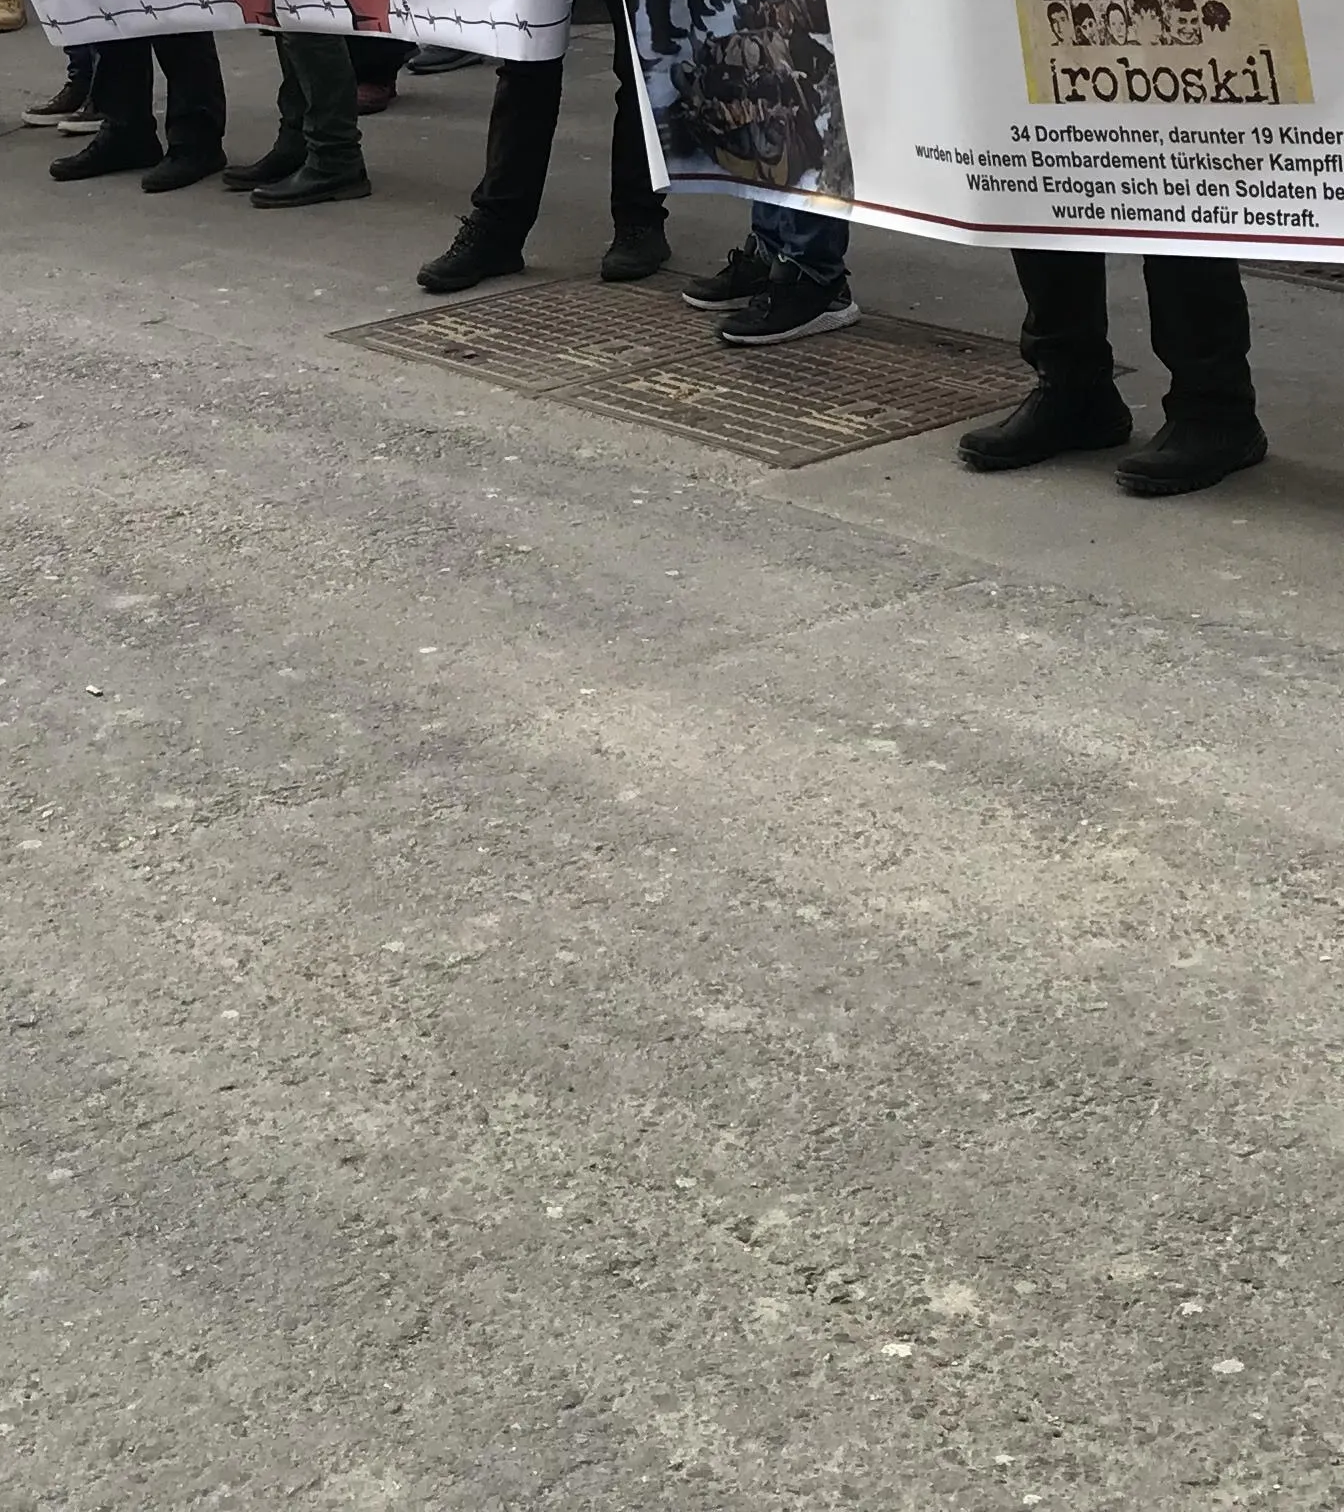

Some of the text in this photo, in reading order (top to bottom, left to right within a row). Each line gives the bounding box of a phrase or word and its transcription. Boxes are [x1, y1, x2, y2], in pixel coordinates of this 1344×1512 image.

[1010, 125, 1031, 142] 34
[1035, 125, 1164, 145] Dorfbewohner,
[1168, 126, 1245, 144] darunter
[1251, 126, 1273, 144] 19
[915, 144, 952, 163] wurden
[955, 147, 974, 166] bei
[978, 150, 1027, 168] einem
[1031, 150, 1166, 170] Bombardement
[1170, 153, 1263, 172] türkischer
[966, 173, 1039, 193] Während
[1043, 176, 1117, 197] Erdogan
[1120, 177, 1158, 196] sich
[1163, 178, 1191, 196] bei
[1196, 179, 1230, 197] den
[1235, 180, 1317, 200] Soldaten
[1052, 204, 1320, 228] wurde niemand dafür bestraft.
